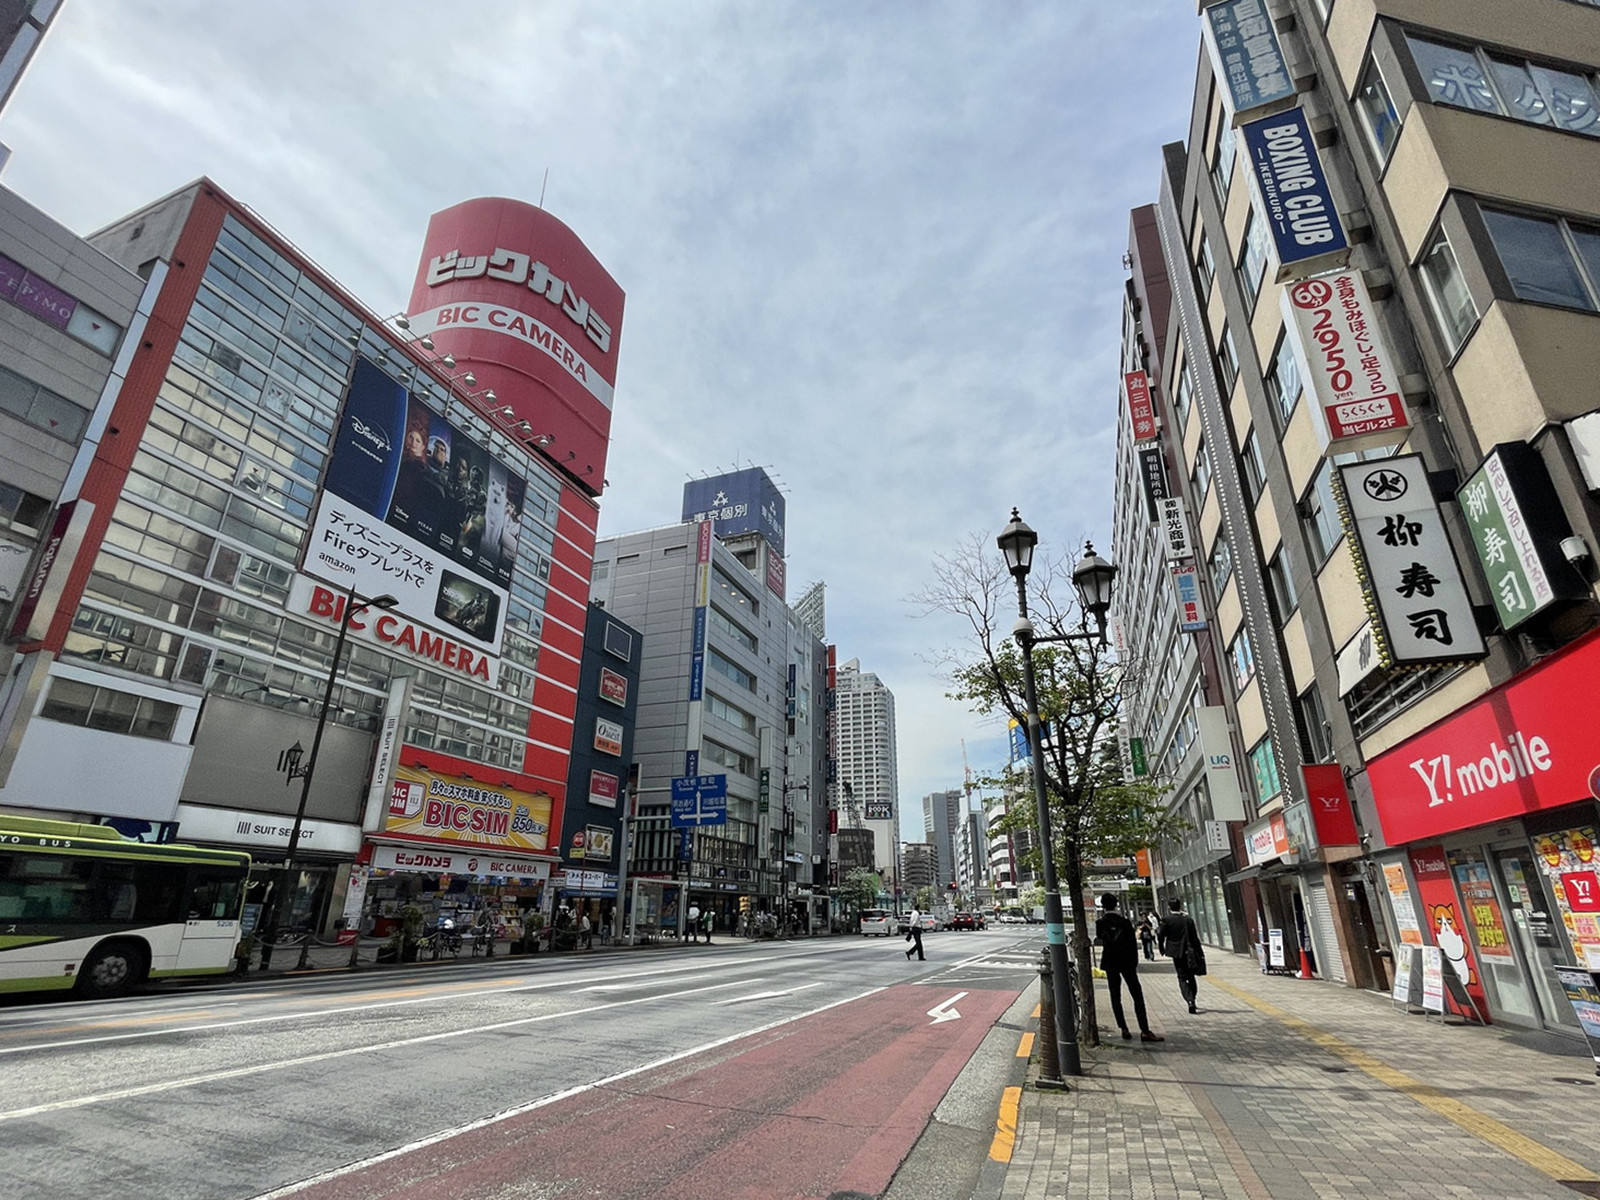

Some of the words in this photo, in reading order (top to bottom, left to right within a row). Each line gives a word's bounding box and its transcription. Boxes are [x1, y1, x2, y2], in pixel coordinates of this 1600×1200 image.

[1263, 123, 1316, 193] BOXING
[1258, 162, 1284, 221] IKEBUKURO
[1285, 195, 1334, 245] CLUB
[426, 248, 611, 353] ビックカメラ
[436, 306, 480, 326] BIC
[488, 310, 588, 384] CAMERA
[1334, 276, 1387, 394] 全身もみほぐし・足うら
[1130, 377, 1151, 433] 丸三証券
[1146, 454, 1162, 500] 明和地所の
[319, 552, 356, 575] amazon
[323, 529, 426, 588] Fireタブレットで
[329, 500, 434, 575] ディズニープラスを
[1465, 480, 1527, 613] 柳寿司
[1376, 513, 1454, 645] 柳寿司
[308, 585, 368, 631] BIC
[374, 615, 490, 682] CAMERA
[383, 731, 392, 750] SUIT
[1210, 755, 1230, 765] UQ
[377, 752, 388, 784] SELECT
[39, 838, 71, 848] BUS
[253, 824, 277, 835] SUIT
[278, 827, 315, 838] SEECT
[425, 800, 469, 831] BIC
[470, 809, 509, 835] SIM
[395, 852, 452, 868] ビックカメラ
[490, 861, 503, 872] BIC
[505, 862, 537, 875] CAMERA
